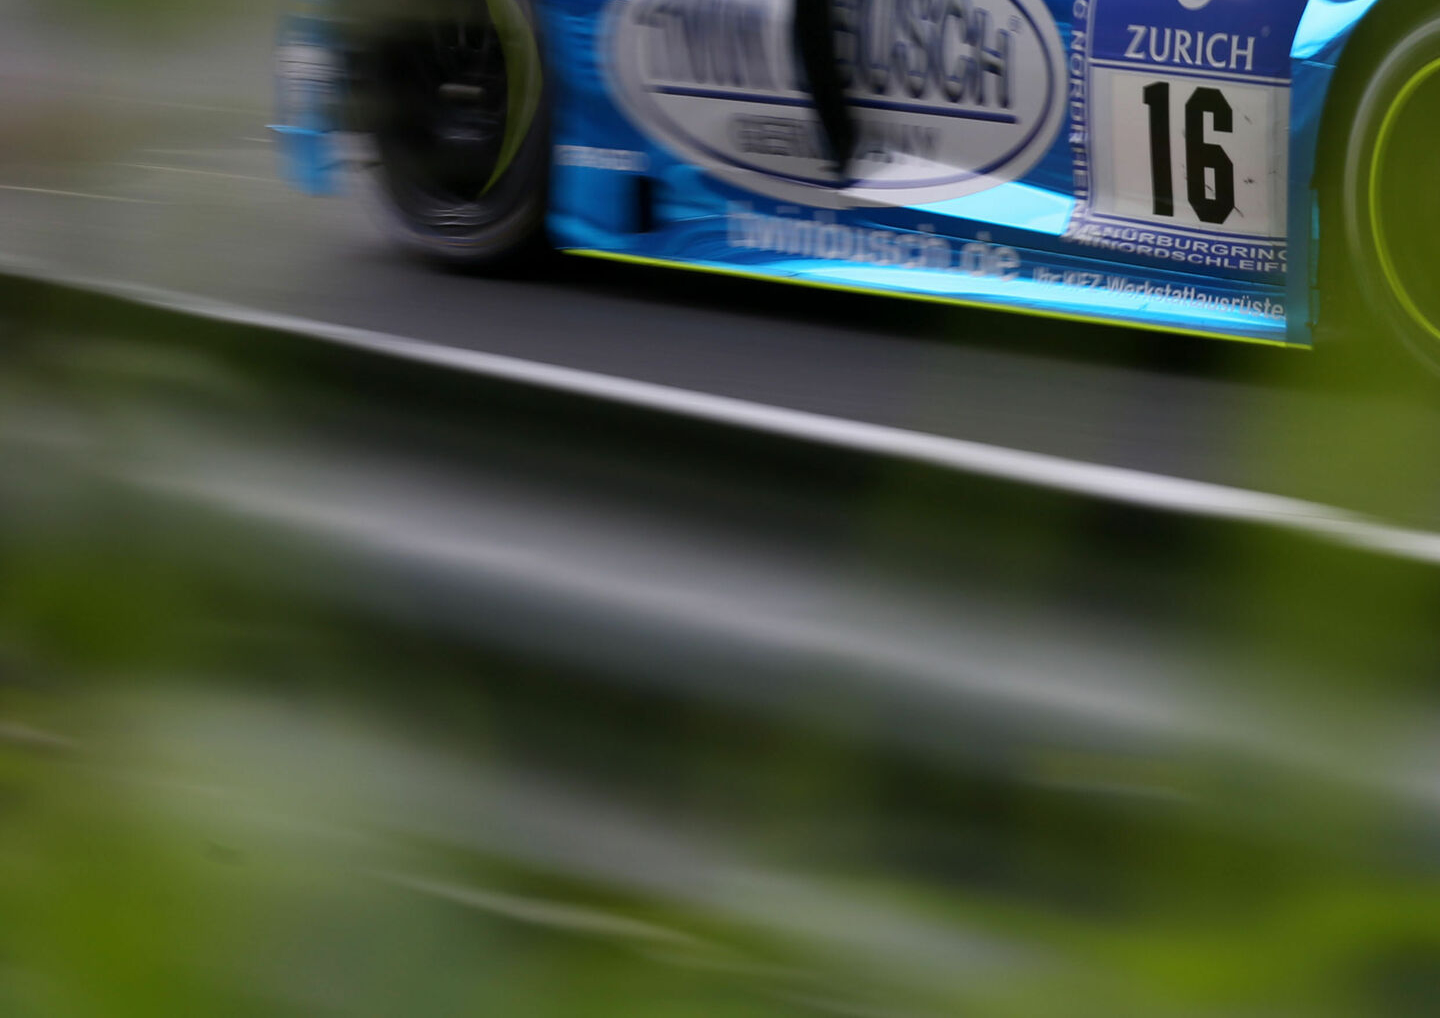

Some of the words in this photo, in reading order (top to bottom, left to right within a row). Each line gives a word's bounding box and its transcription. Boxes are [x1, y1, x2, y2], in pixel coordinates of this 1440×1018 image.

[1124, 24, 1255, 72] ZURICH
[1142, 81, 1236, 225] 16
[1100, 238, 1287, 273] NORDSCHLEIF
[1063, 269, 1288, 321] KFZ-Werkstattausrüste
